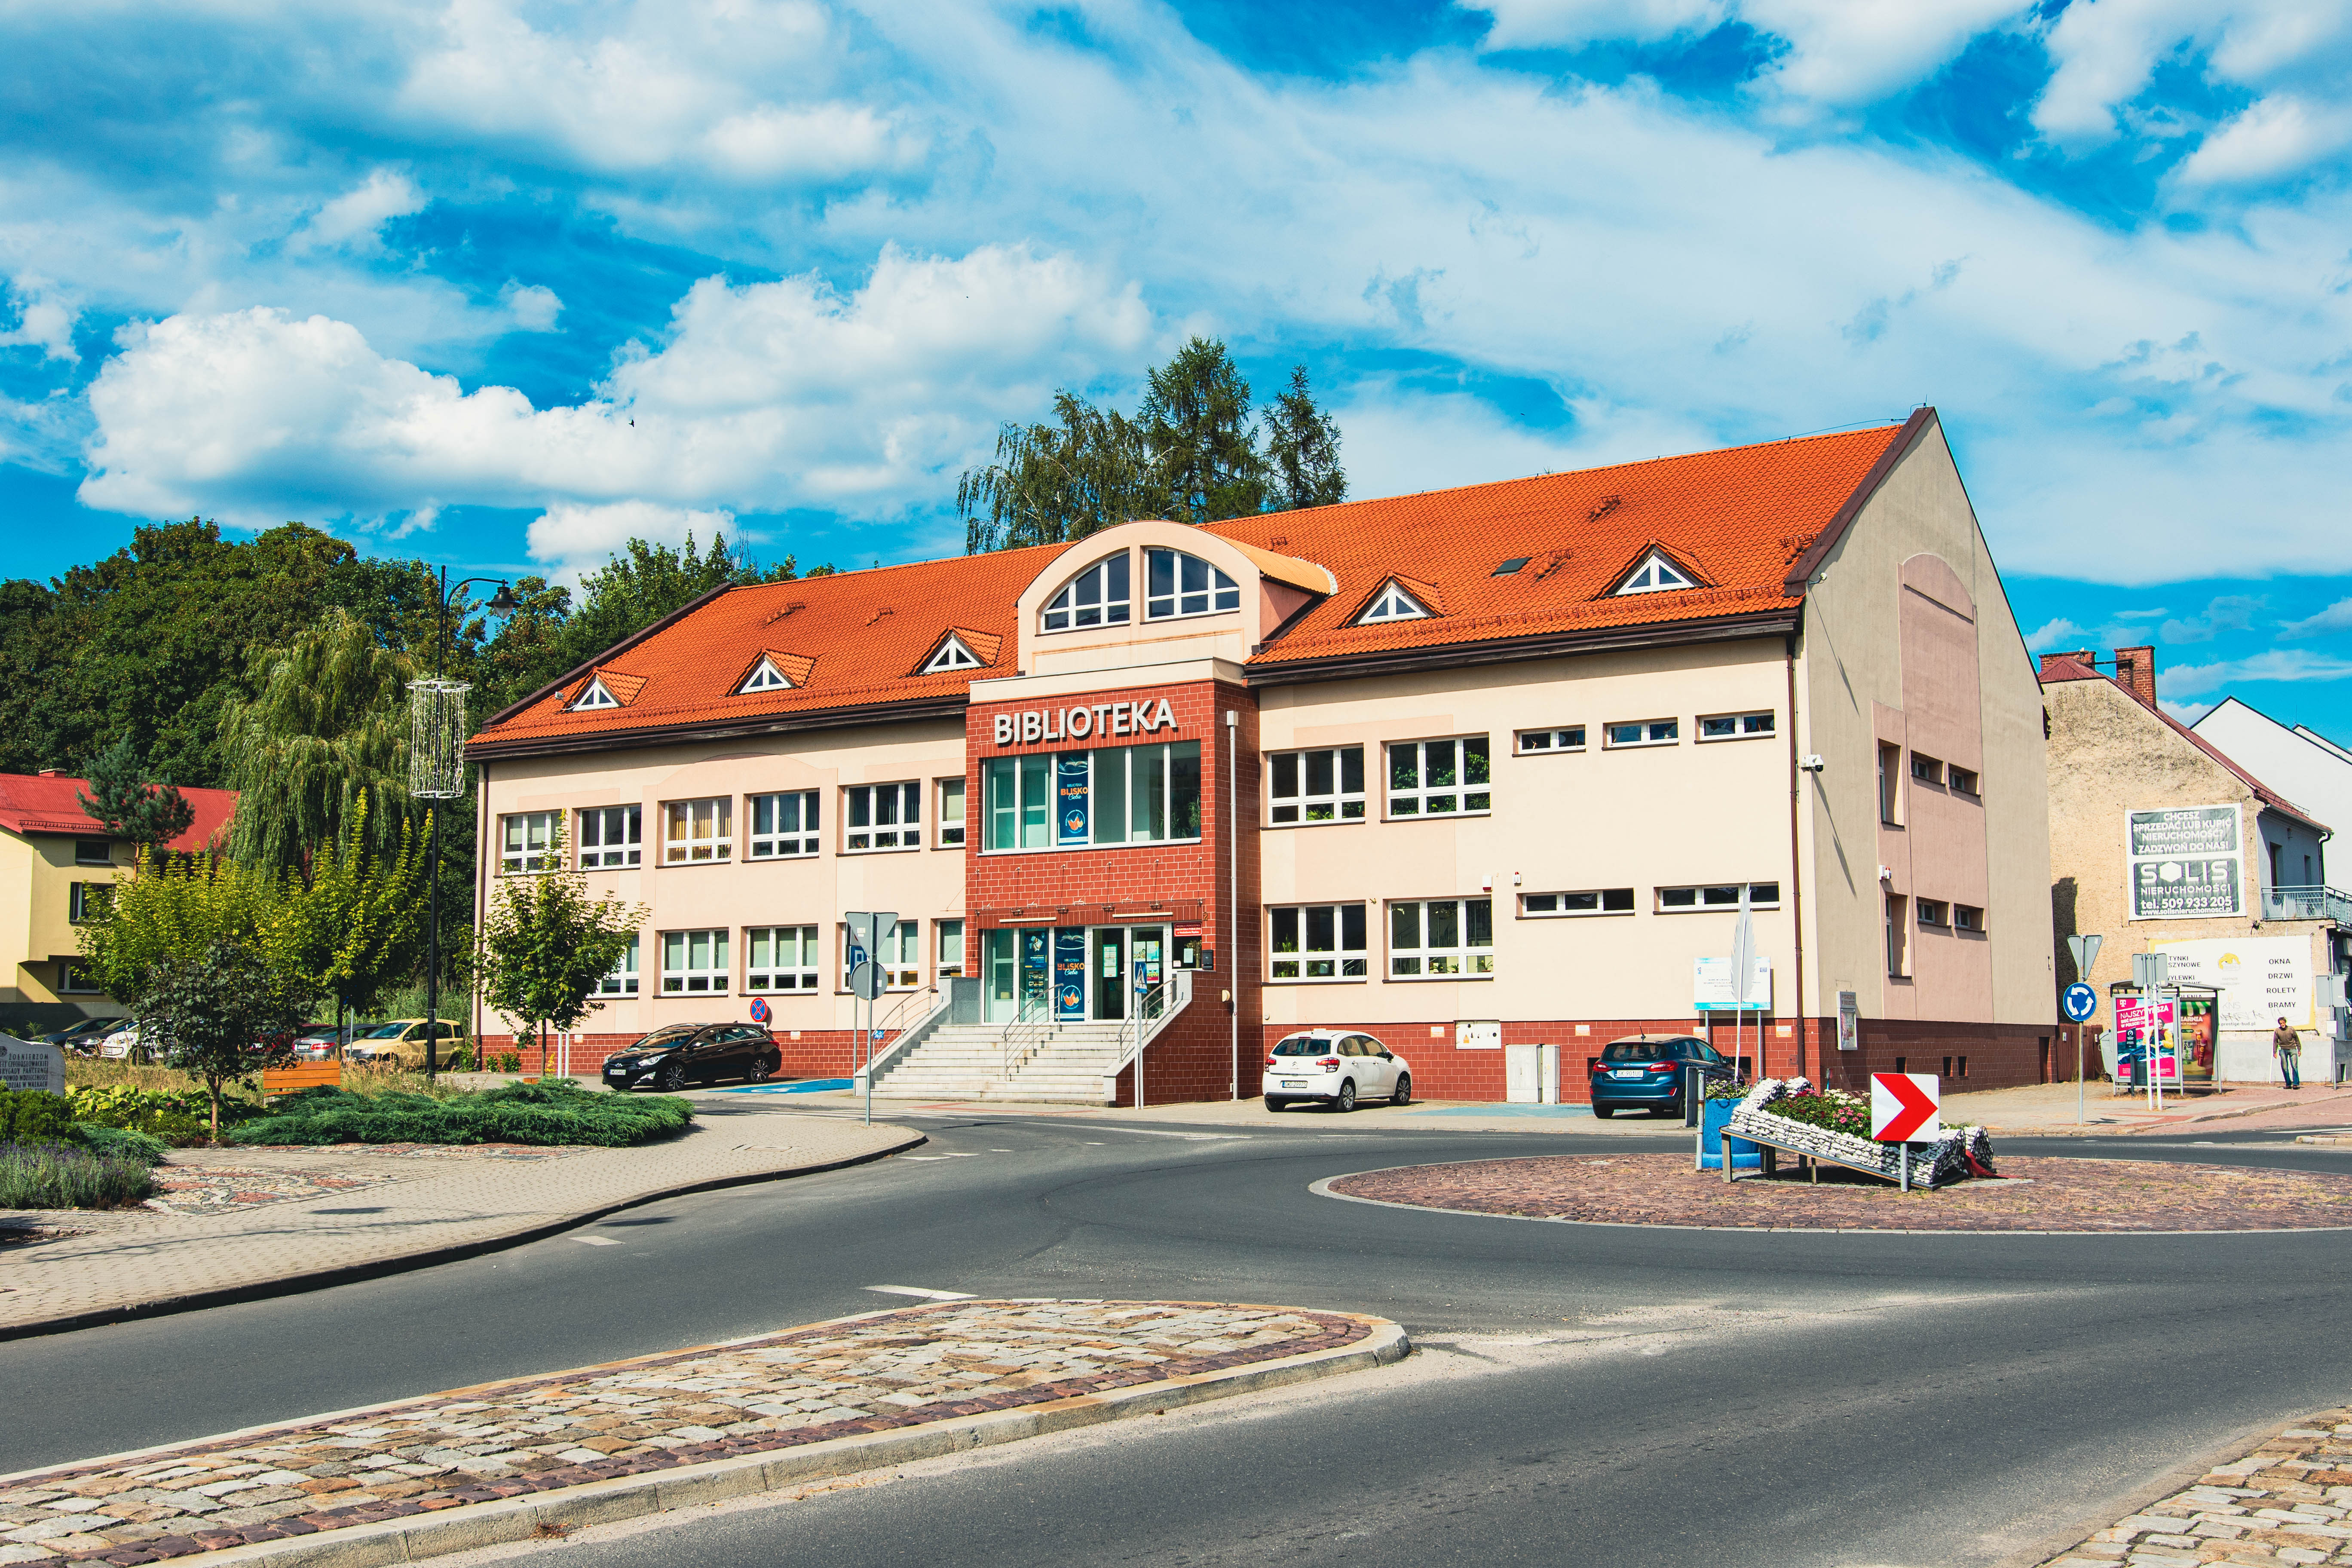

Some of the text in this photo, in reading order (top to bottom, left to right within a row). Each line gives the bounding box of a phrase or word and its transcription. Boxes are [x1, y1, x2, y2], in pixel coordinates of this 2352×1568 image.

[995, 698, 1178, 743] BIBLIOTEKA
[1060, 787, 1088, 796] BLISKO
[2163, 811, 2200, 821] CHCESZ
[2133, 817, 2232, 831] SPRZEDAĆ LUB KUPIĆ
[2142, 829, 2224, 841] NIERUCHOMOŚĆ?
[2138, 841, 2229, 854] ZADZWOŃ DO NAS!
[2141, 883, 2231, 895] NIERUCHOMOŚCI
[2141, 896, 2232, 909] tel. 509 933 205
[1203, 912, 1208, 921] 2
[2141, 906, 2233, 916] www.solisnieruchomosci.pl
